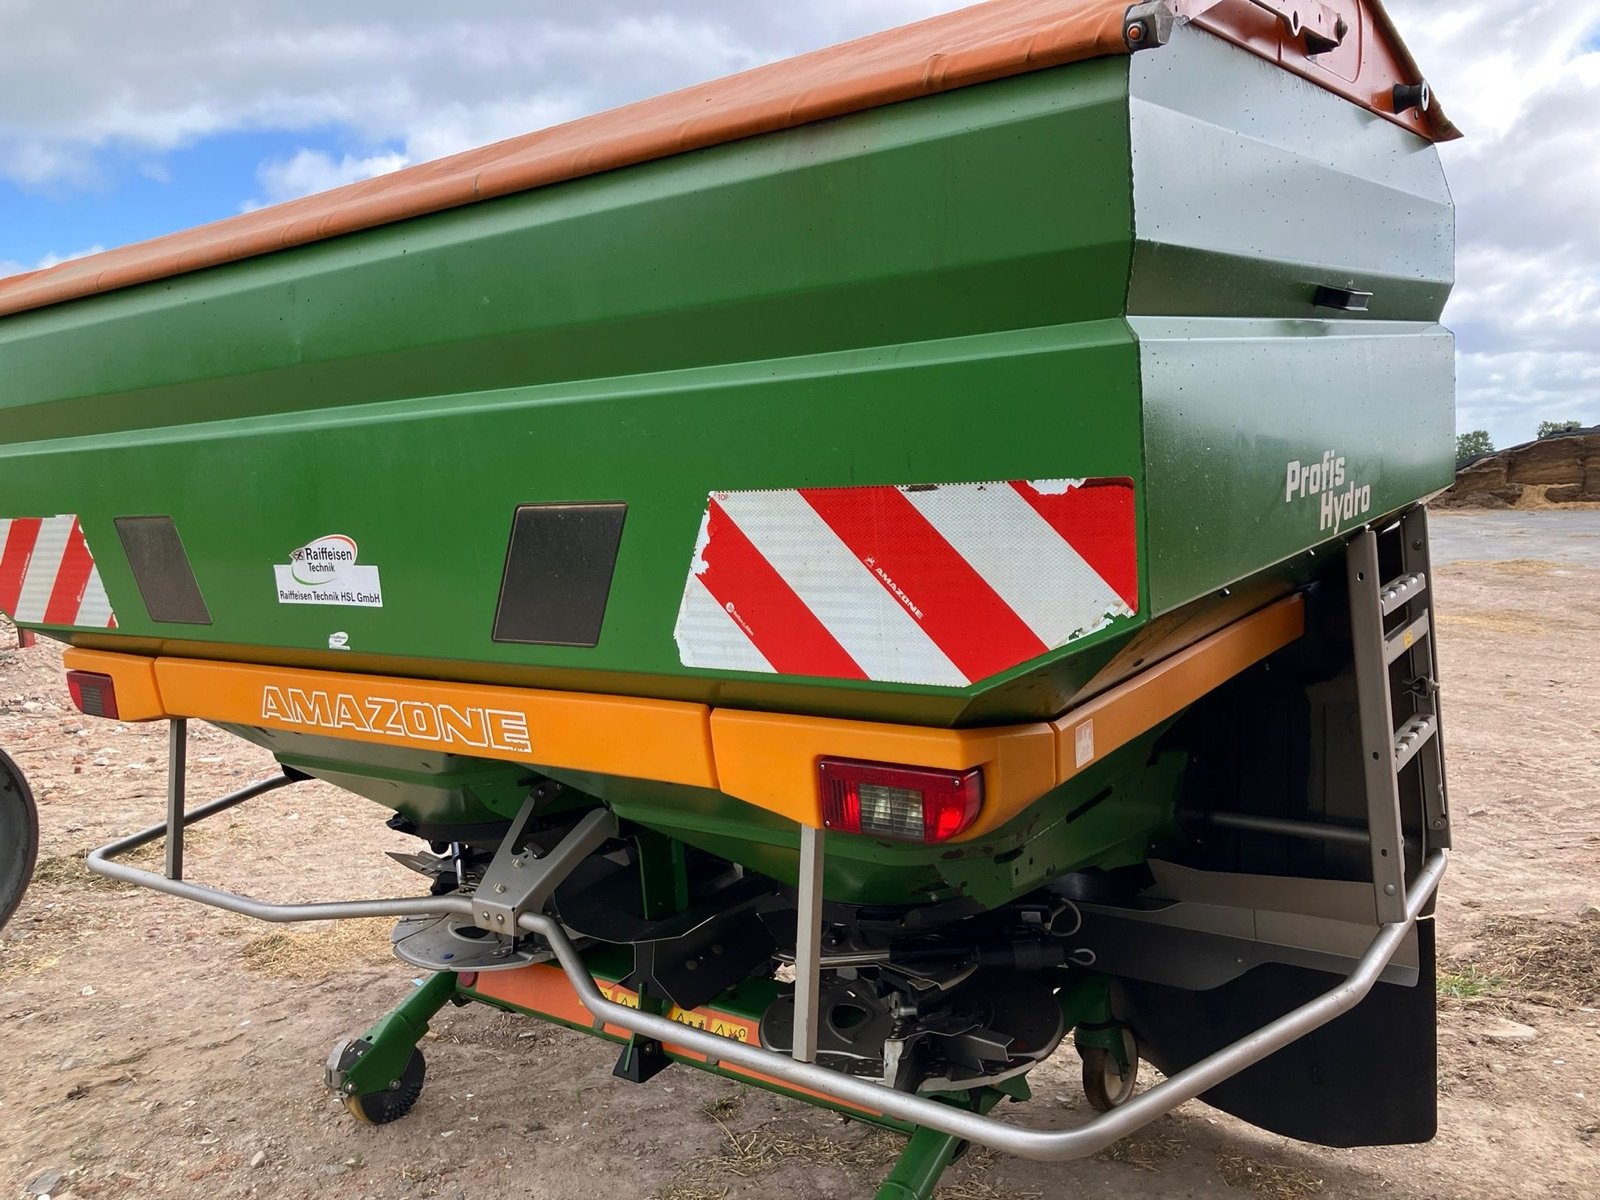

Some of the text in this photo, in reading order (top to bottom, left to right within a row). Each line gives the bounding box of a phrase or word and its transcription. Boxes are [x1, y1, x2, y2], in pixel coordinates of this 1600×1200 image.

[1285, 449, 1345, 503] Profis
[1320, 480, 1371, 535] Hydro
[304, 547, 353, 561] Raiffeisen
[307, 562, 336, 573] Technik
[279, 590, 381, 603] Raiffeisen Technik HSL GmbH
[875, 567, 924, 620] AMAZONE
[261, 685, 533, 753] AMAZONE
